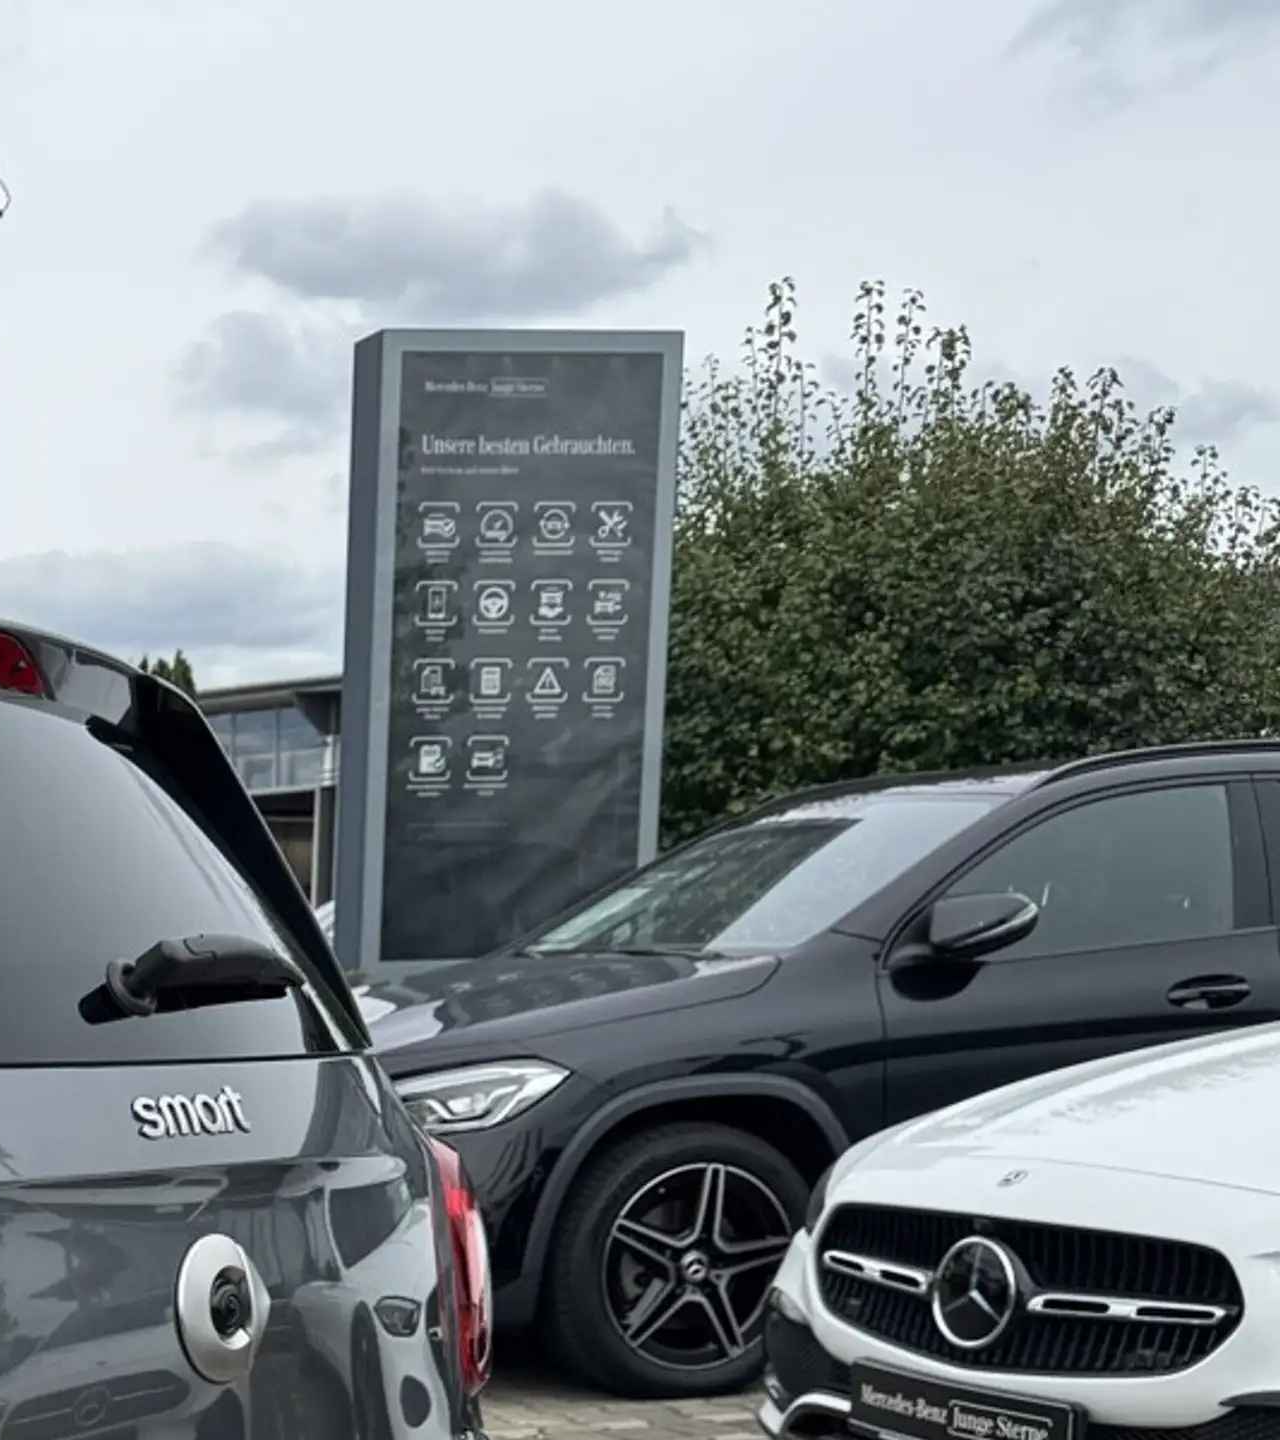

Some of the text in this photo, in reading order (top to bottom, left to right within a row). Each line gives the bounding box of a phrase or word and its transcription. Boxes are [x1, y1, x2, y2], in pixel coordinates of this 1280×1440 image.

[422, 434, 635, 455] Unsere besten Gebrauchten.
[132, 1085, 251, 1138] smart
[861, 1383, 947, 1426] Mercedes-Benz
[954, 1405, 994, 1434] Junge
